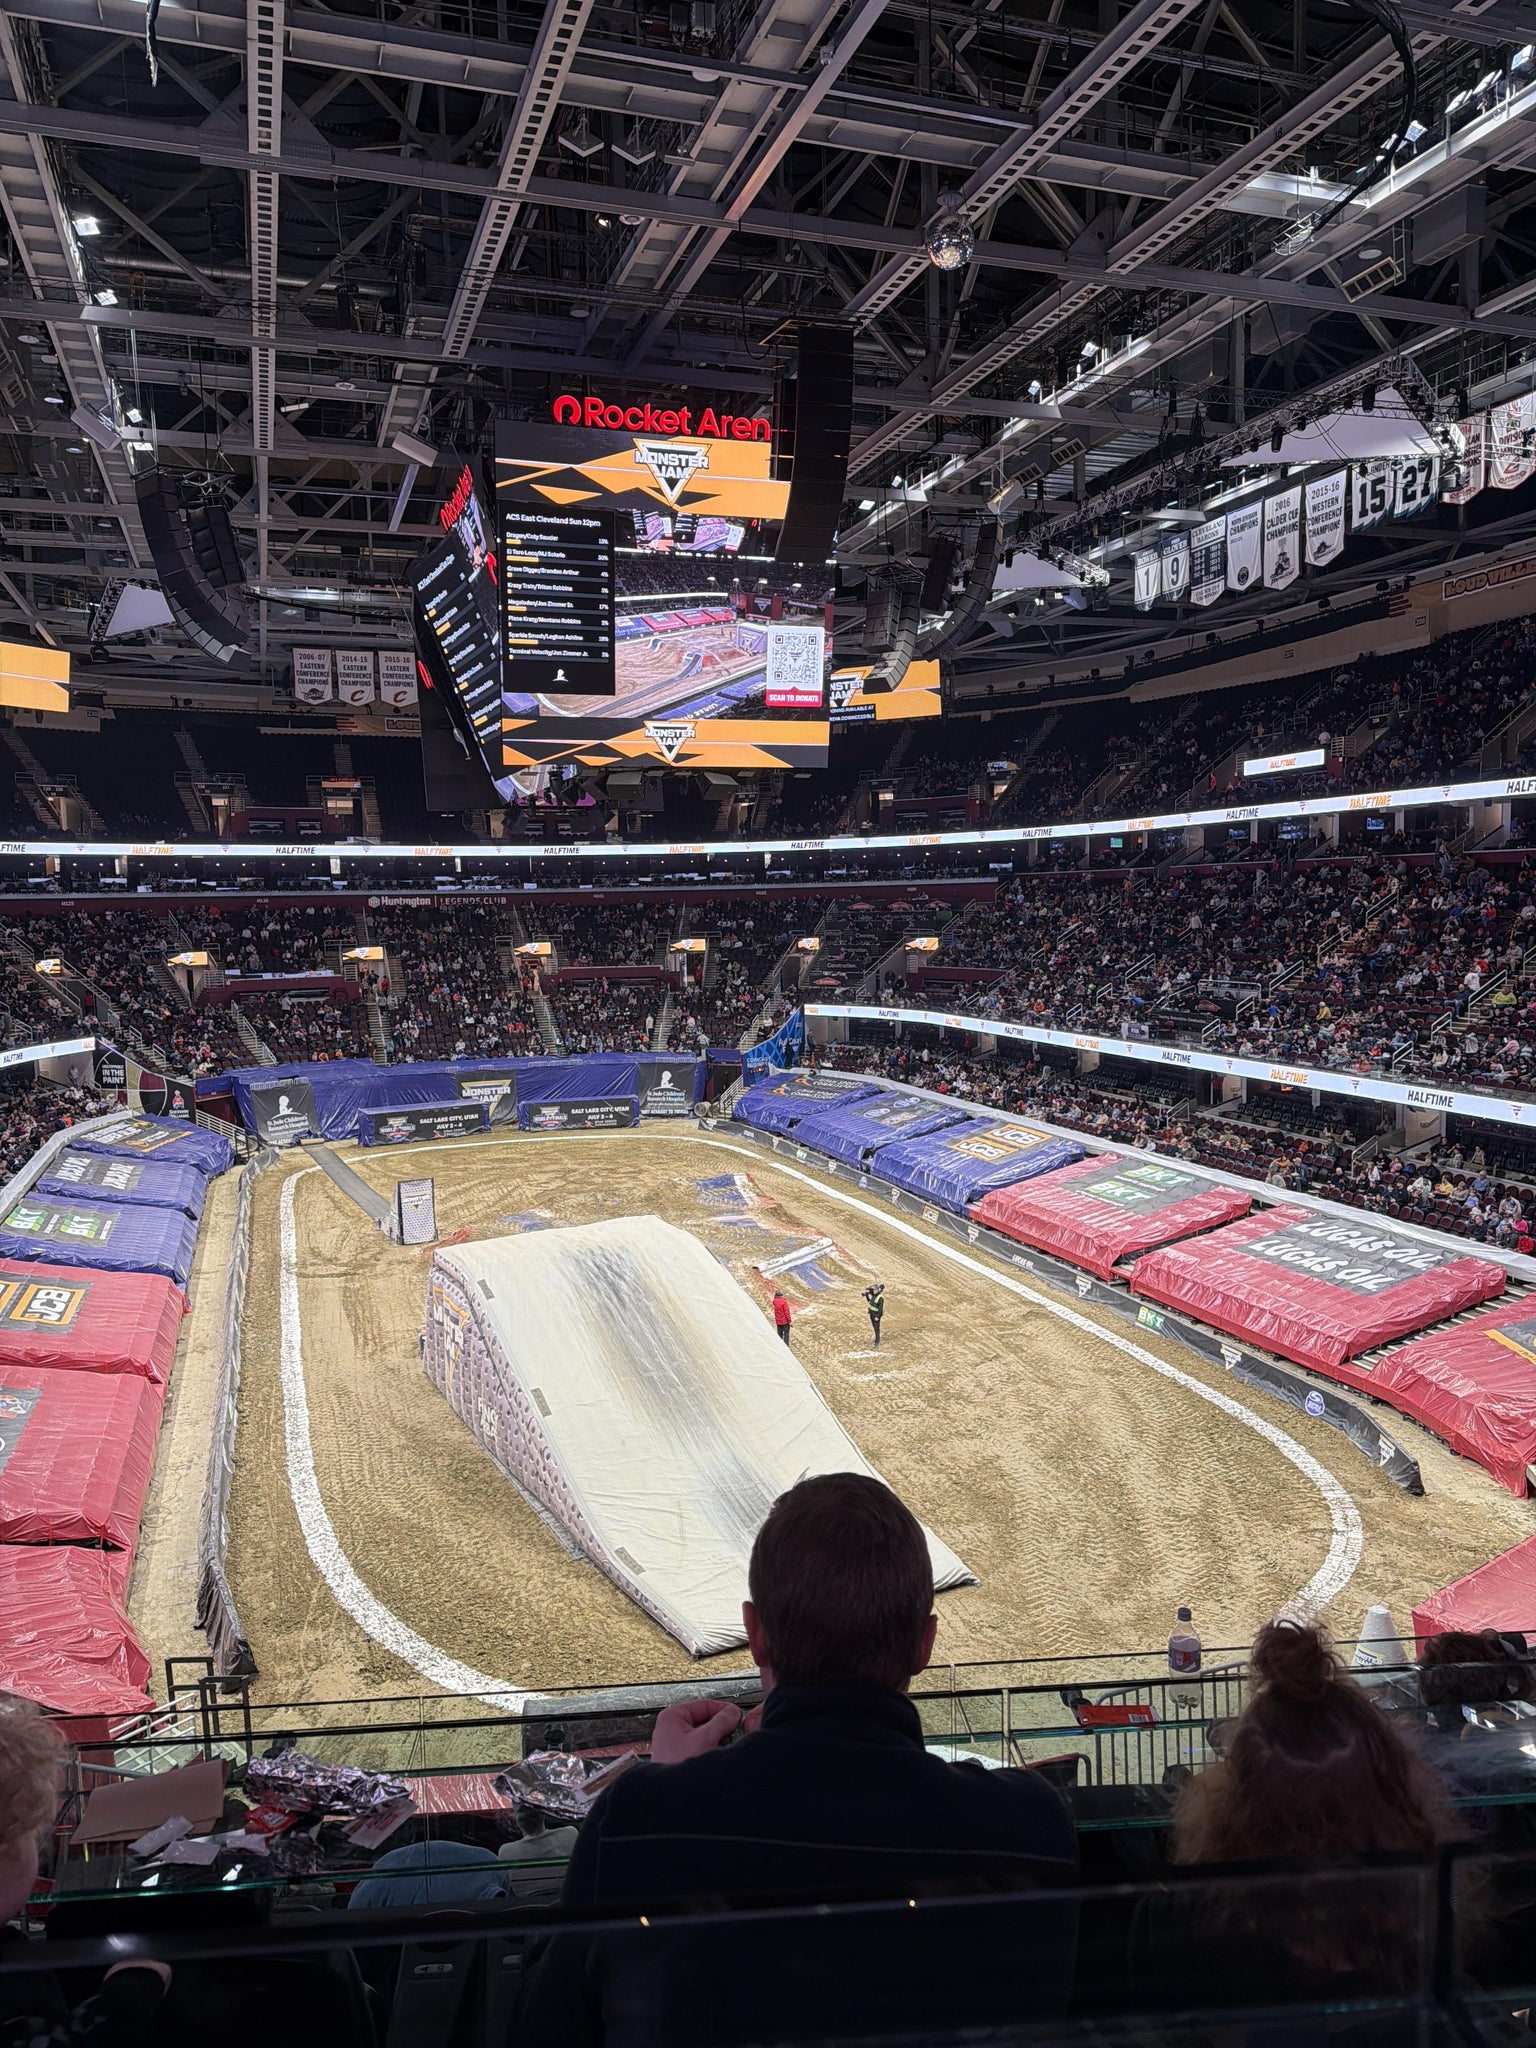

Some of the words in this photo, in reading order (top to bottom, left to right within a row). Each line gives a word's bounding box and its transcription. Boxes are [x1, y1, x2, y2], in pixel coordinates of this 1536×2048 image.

[584, 397, 692, 435] Rocket
[697, 408, 771, 441] Aren
[635, 450, 709, 469] MONSTER
[653, 464, 689, 480] JAM
[1311, 481, 1340, 499] 2015-16
[1359, 475, 1386, 519] 15
[1275, 498, 1290, 511] 2016
[1311, 495, 1339, 513] WESTERN
[521, 514, 536, 522] East
[536, 515, 568, 525] Cleveland
[582, 519, 601, 527] 12pm
[1230, 518, 1258, 536] CHAMPIONS
[1266, 513, 1287, 529] CALDER
[1192, 519, 1224, 538] CLEVELAND
[1266, 521, 1298, 541] CHAMPIONS
[1308, 519, 1341, 538] CHAMPIONS
[1163, 540, 1188, 555] GLOVER
[1170, 557, 1180, 586] 9
[1144, 568, 1150, 596] 1
[300, 662, 325, 670] EASTERN
[341, 655, 368, 663] 2014-15
[296, 670, 330, 678] CONFERENCE
[787, 694, 795, 702] TO
[796, 694, 819, 703] DONATE
[645, 729, 696, 738] MONSTER
[660, 737, 681, 746] JAM
[1269, 757, 1296, 769] HALFTIME
[1349, 794, 1392, 809] HALFTIME
[1226, 807, 1259, 820] HALFTIME
[1127, 819, 1154, 831] HALFTIME
[909, 835, 942, 845] HALFTIME
[1022, 828, 1053, 838] HALFTIME
[132, 846, 174, 855] HALFTIME
[276, 846, 316, 855] HALFTIME
[414, 847, 453, 856] HALFTIME
[544, 846, 580, 854] HALFTIME
[669, 845, 705, 854] HALFTIME
[791, 841, 825, 850] HALFTIME
[381, 896, 431, 908] Huntington
[440, 897, 482, 906] LEGENDS
[484, 896, 507, 905] CLUB
[878, 1010, 900, 1018] HALFTIME
[1004, 1026, 1024, 1036] HALFTIME
[1075, 1037, 1100, 1049] HALFTIME
[3, 1052, 23, 1062] HALFTIME
[1161, 1050, 1191, 1065] HALFTIME
[1270, 1067, 1308, 1084] HALFTIME
[461, 1086, 511, 1097] MONSTER
[1407, 1088, 1454, 1108] HALFTIME
[268, 1124, 289, 1132] Research
[289, 1120, 309, 1128] Hospital
[273, 1119, 284, 1127] Jude
[284, 1115, 308, 1124] Children's
[992, 1128, 1041, 1145] JCB
[959, 1141, 1006, 1158] JCB
[1133, 1166, 1191, 1185] BKT
[1090, 1182, 1152, 1200] BKT
[10, 1208, 42, 1229] BKT
[66, 1215, 96, 1236] BKT
[1293, 1222, 1396, 1252] LUCAS
[1012, 1254, 1027, 1266] LUCAS
[1248, 1240, 1349, 1272] LUCAS
[28, 1289, 71, 1321] JCB
[1138, 1307, 1164, 1329] BKT
